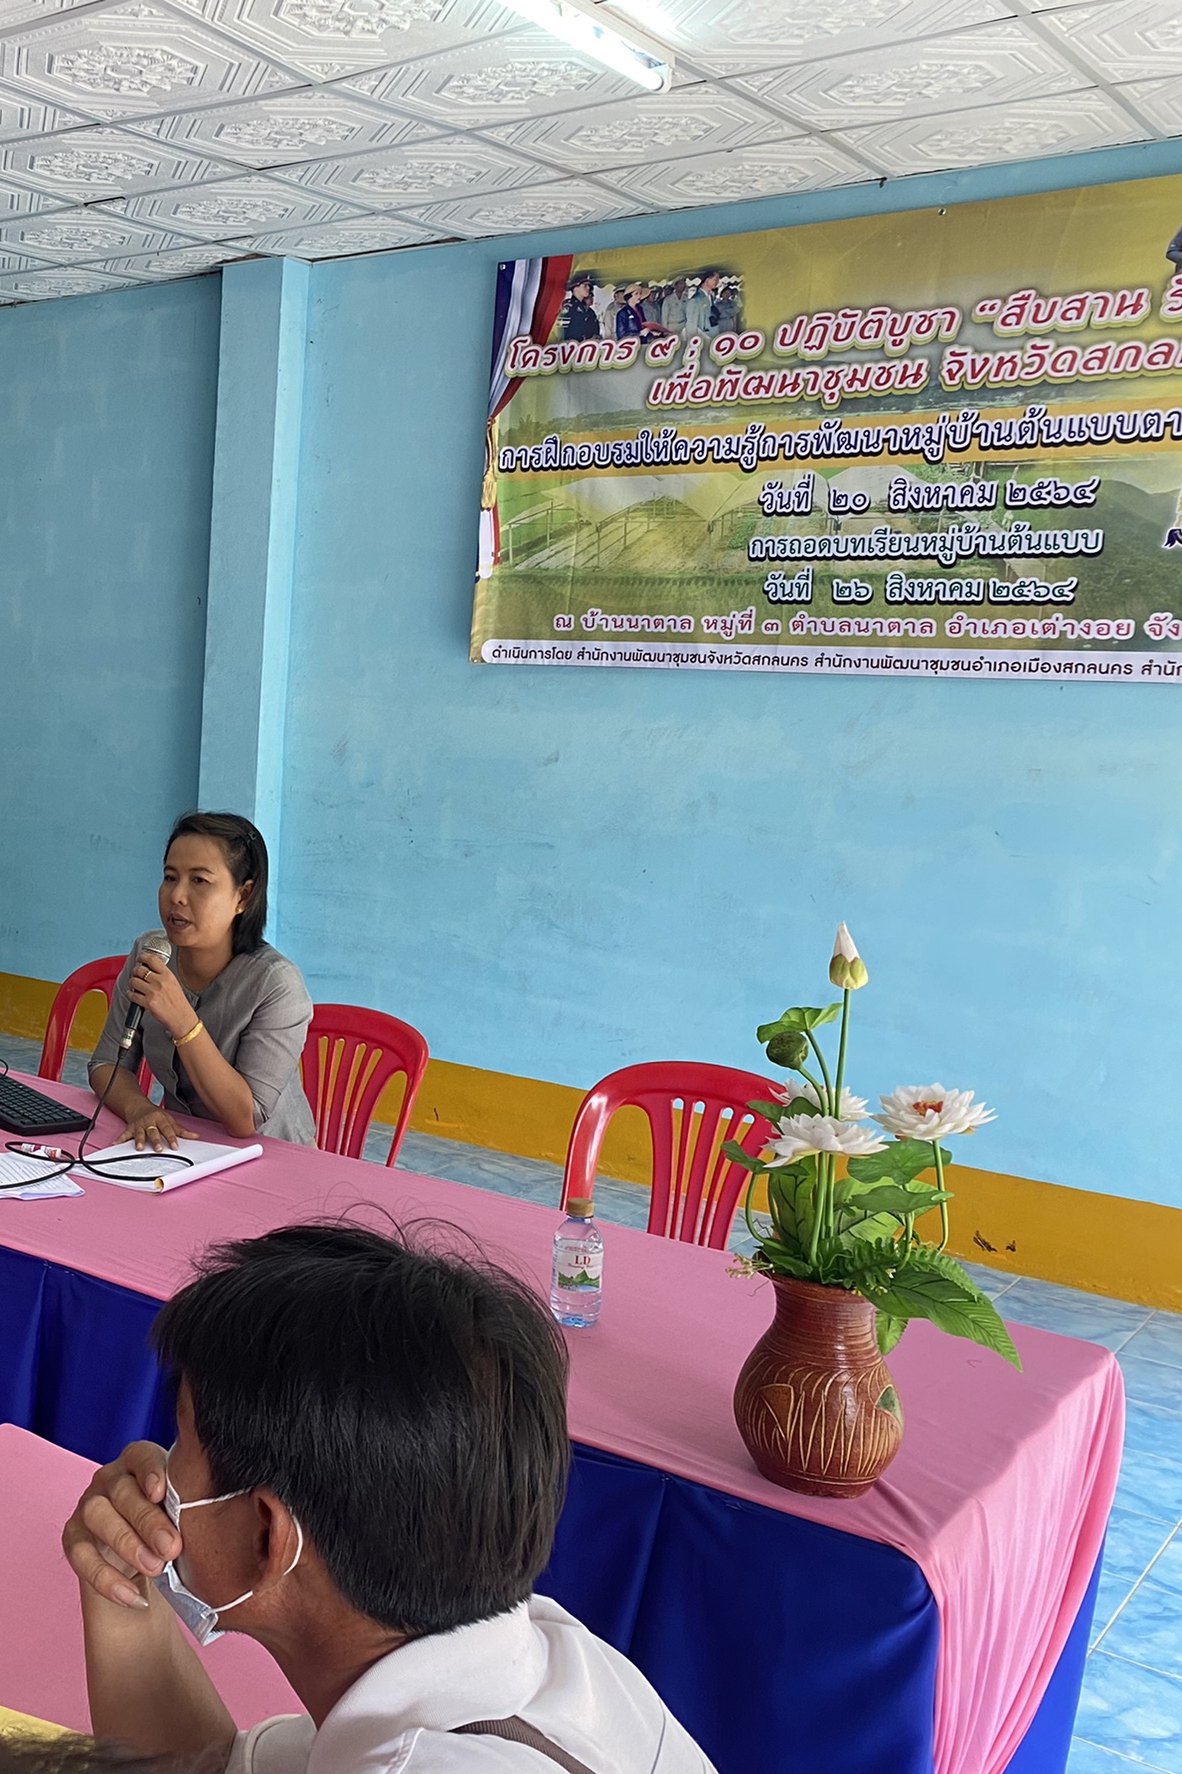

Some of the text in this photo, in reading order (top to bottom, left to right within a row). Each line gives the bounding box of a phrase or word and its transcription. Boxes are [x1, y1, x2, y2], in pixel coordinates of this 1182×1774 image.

[508, 337, 636, 369] โครงการ
[714, 333, 761, 358] ๑๐
[777, 308, 957, 352] ปฏิบัติบูชา
[650, 341, 1182, 401] เพื่อพัฒนาชุมชน จังหวัดสกล
[761, 474, 1098, 513] วันที่ ๒๐ สิงหาคม ๒๕๖๔
[750, 523, 1102, 562] การถอดบทเรียนหมู่บ้านต้นแบบ
[765, 567, 1077, 599] วันที่ ๒๖ สิงหาคม ๒๕๖๔
[555, 607, 1182, 638] ณ บ้านนาตาล หมู่ที่ ๓ ตำบลนาตาล อำเภอเต่างอย จัง
[491, 645, 573, 661] ดำเนินการโดย
[576, 646, 809, 668] สำนักงานพัฒนาชุมชนจังหวัดสกลนคร
[814, 653, 1134, 676] สำนักงานพัฒนาชุมชนอำเภอเมืองสกลนคร
